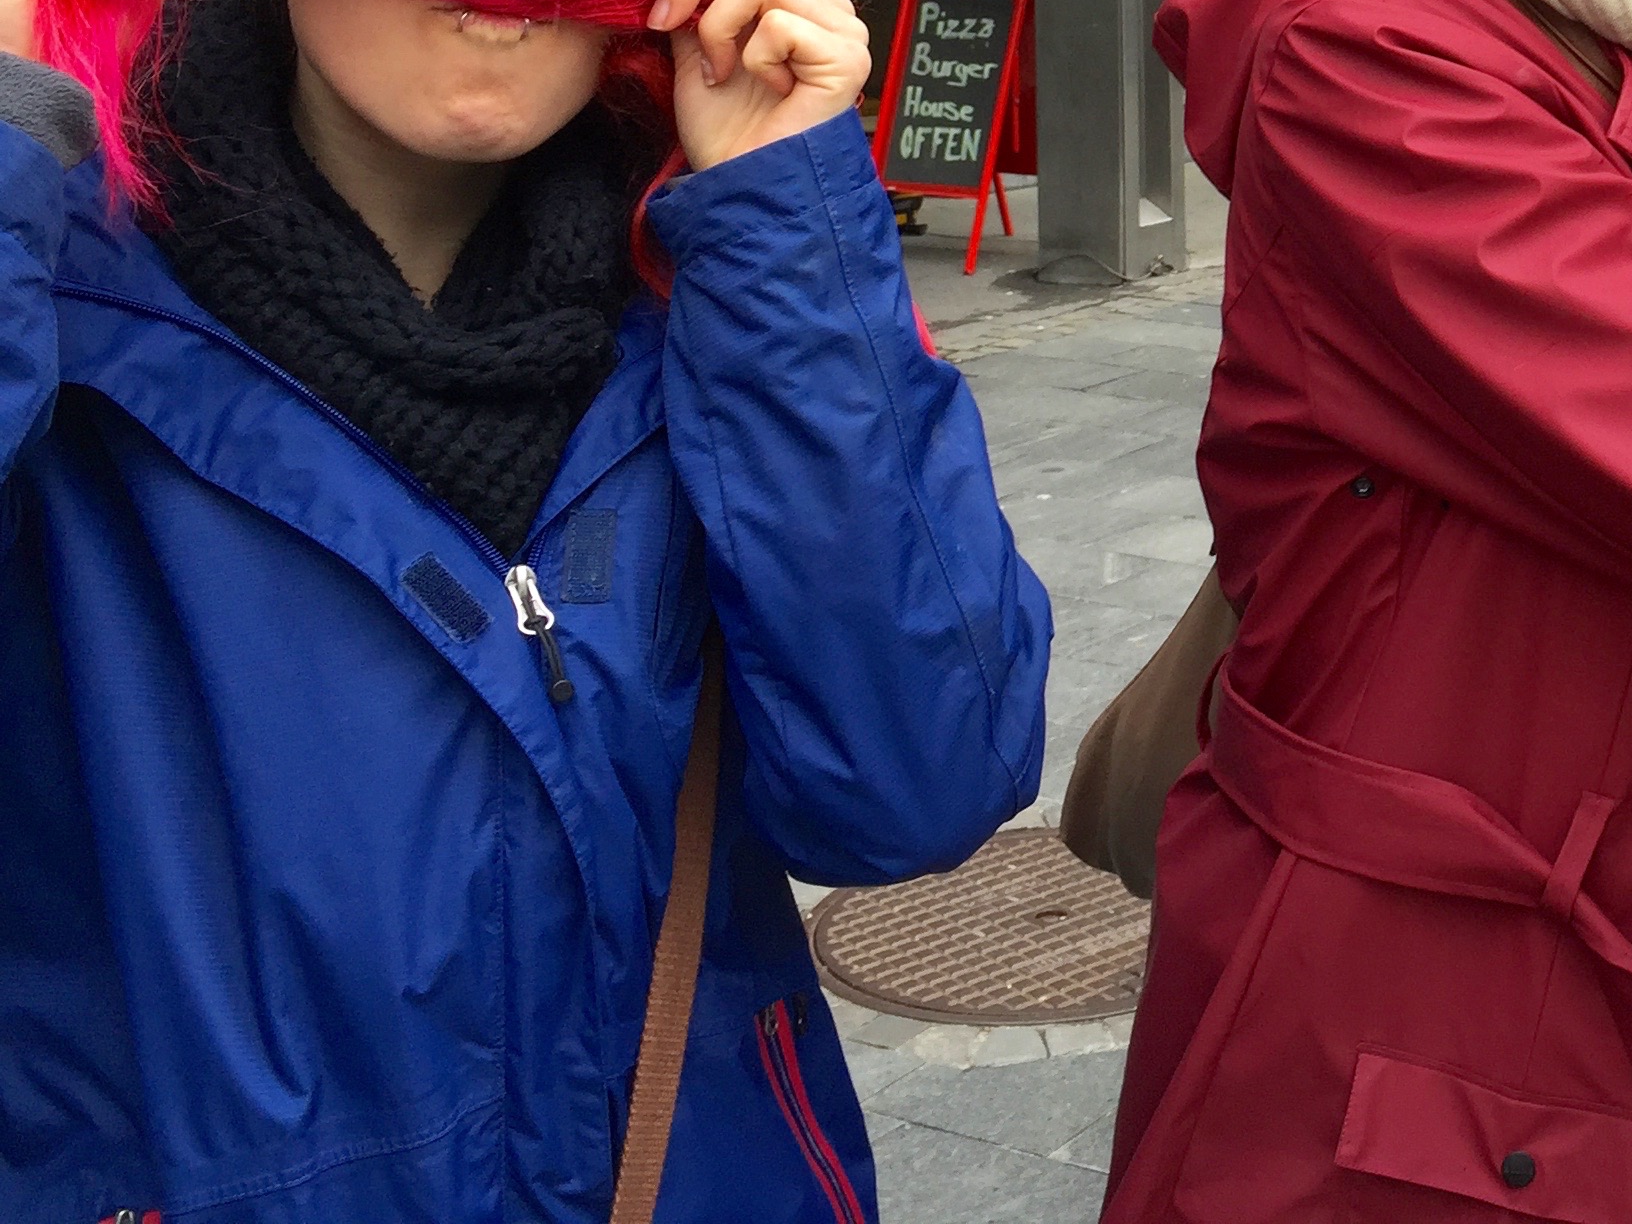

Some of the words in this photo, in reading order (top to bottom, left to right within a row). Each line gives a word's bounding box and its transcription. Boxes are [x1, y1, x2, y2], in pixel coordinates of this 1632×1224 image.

[918, 2, 996, 40] Pizza
[911, 42, 998, 87] Burger
[904, 85, 974, 122] House
[899, 126, 982, 162] OFFEN
